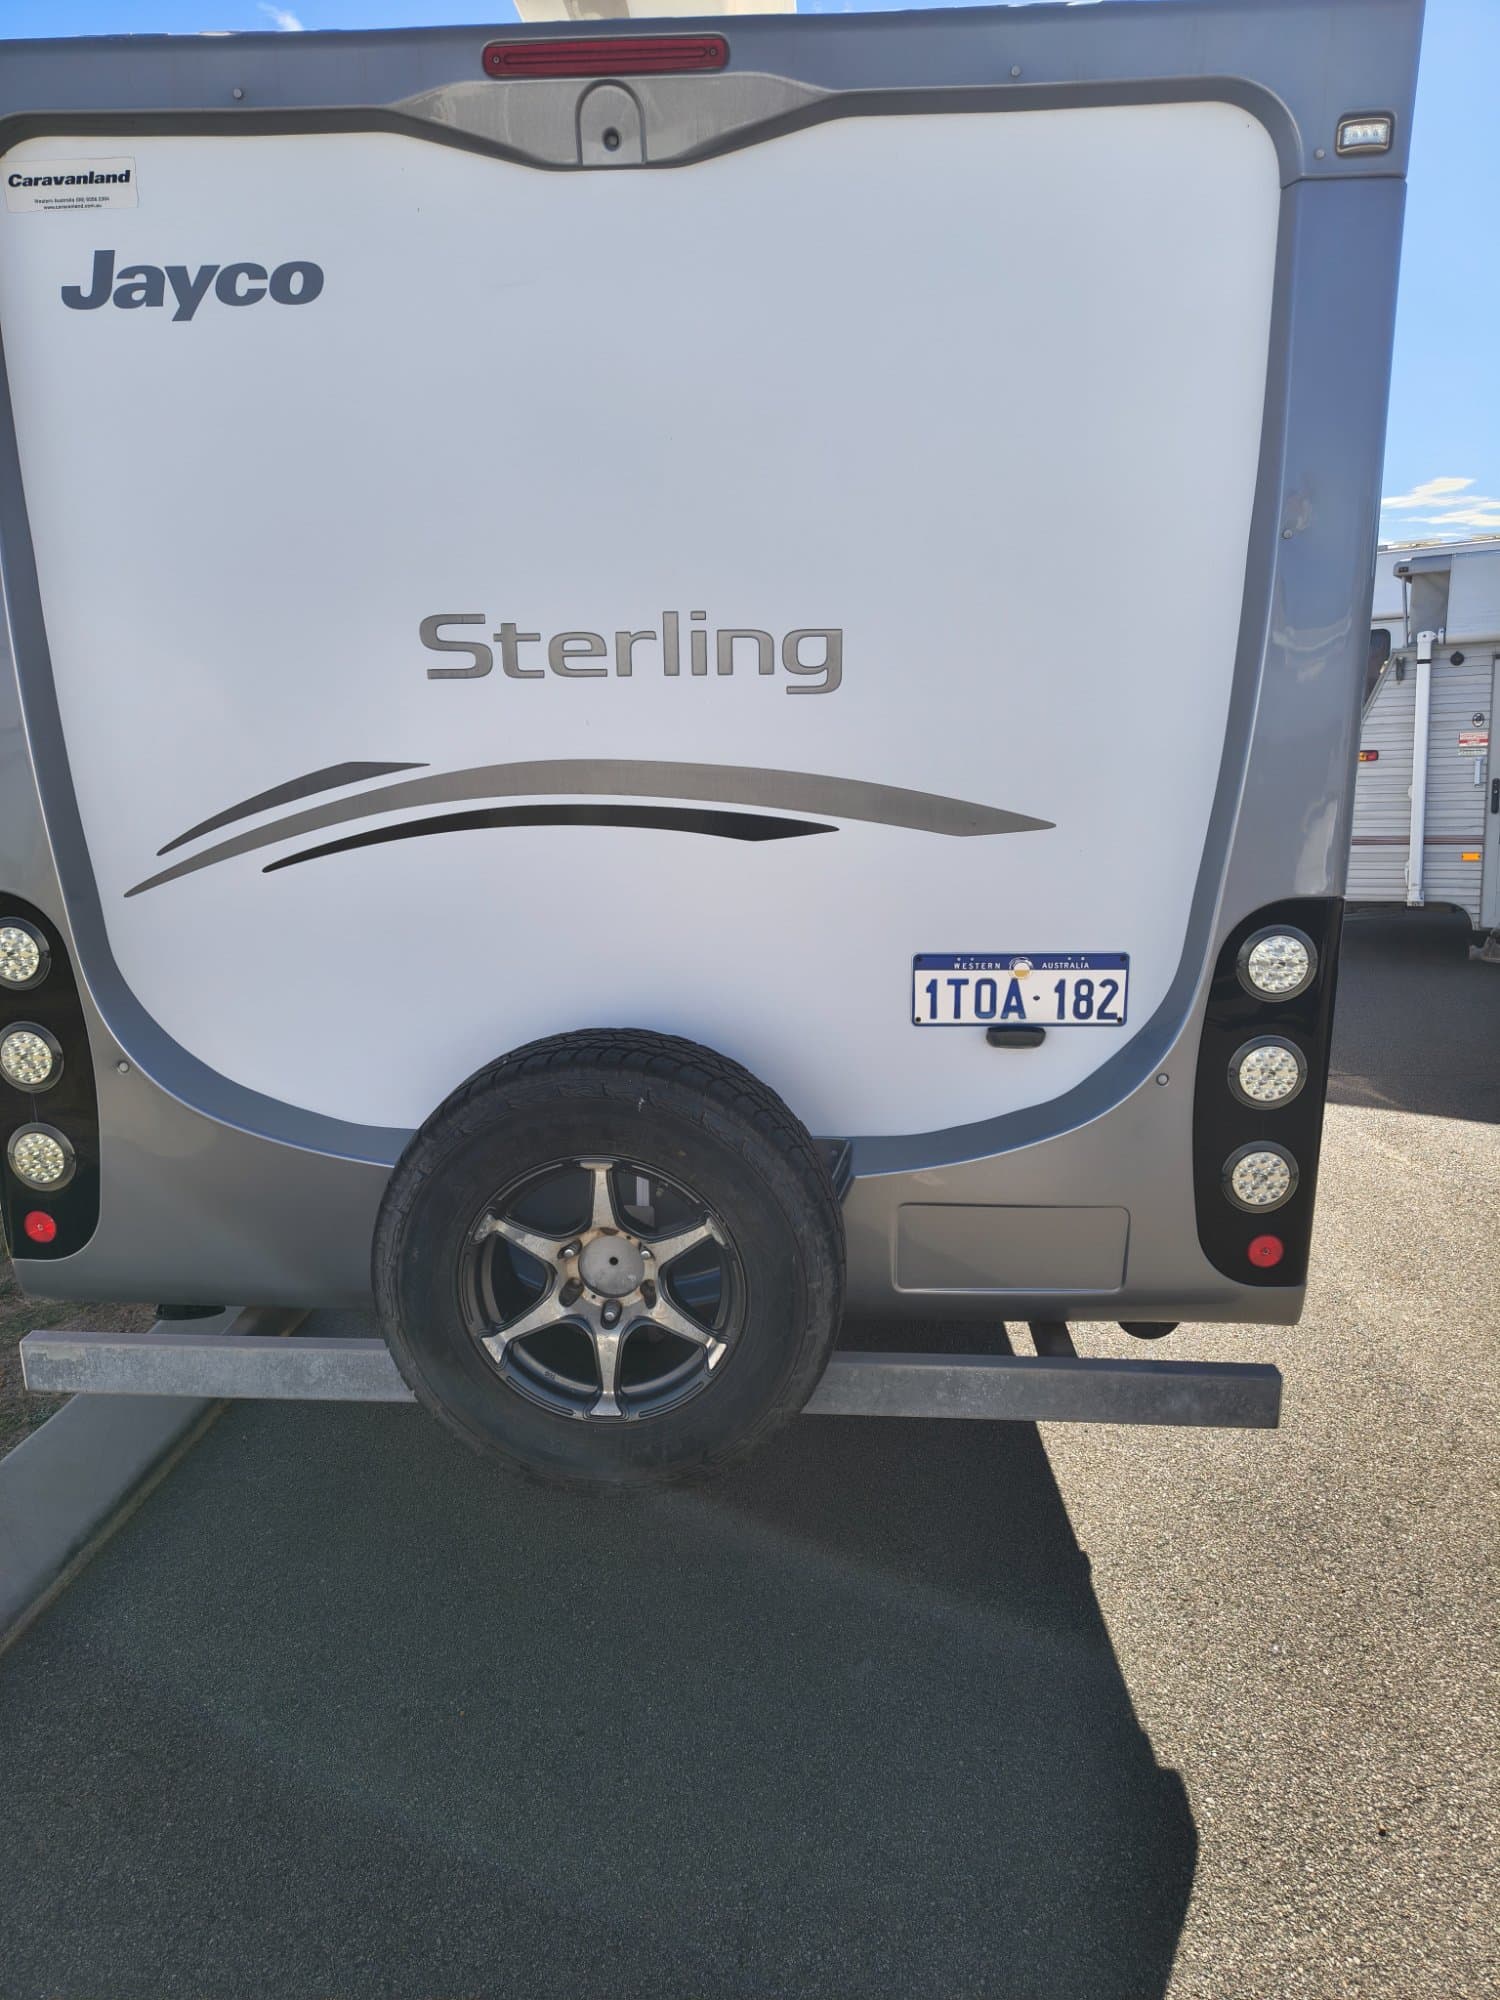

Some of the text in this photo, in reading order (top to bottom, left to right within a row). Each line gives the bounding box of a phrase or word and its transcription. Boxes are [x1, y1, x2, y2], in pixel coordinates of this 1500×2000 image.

[8, 170, 131, 188] Caravanland
[61, 249, 325, 322] Jayco
[418, 610, 844, 695] Sterling
[953, 961, 1090, 970] WESTERN AUSTRALIA
